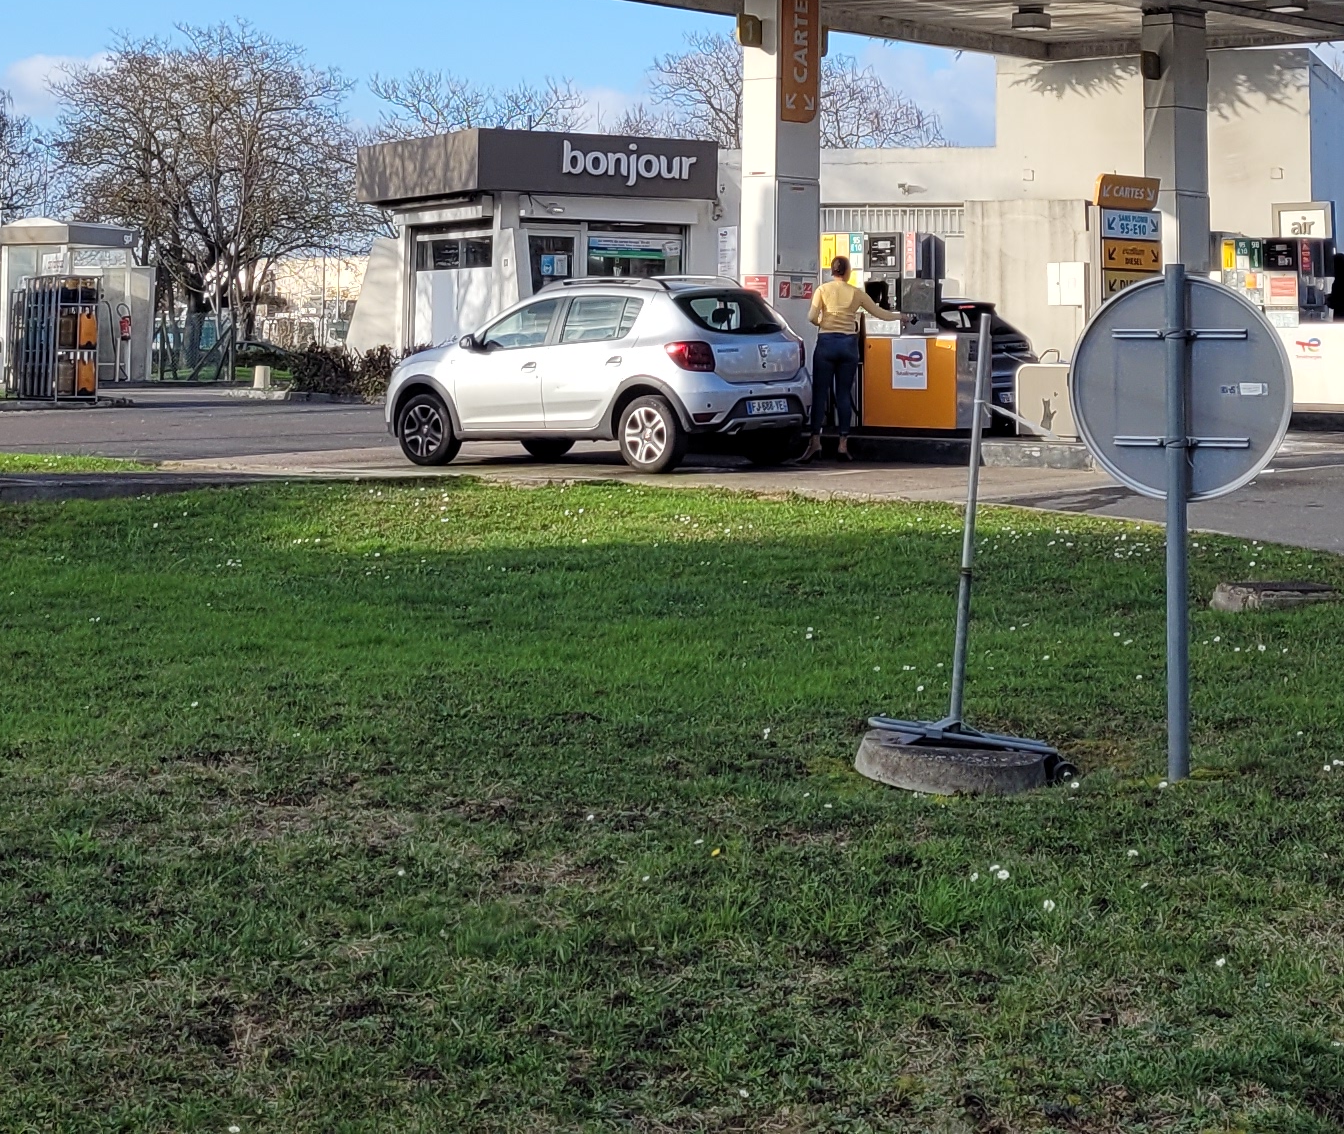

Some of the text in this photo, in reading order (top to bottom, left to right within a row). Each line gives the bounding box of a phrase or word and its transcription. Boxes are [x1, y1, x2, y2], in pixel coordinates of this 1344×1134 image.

[562, 139, 697, 186] bonjour
[1113, 186, 1144, 199] CARTES
[1120, 223, 1147, 235] 95-E10
[1291, 216, 1315, 235] air
[1125, 257, 1143, 266] DIESEL
